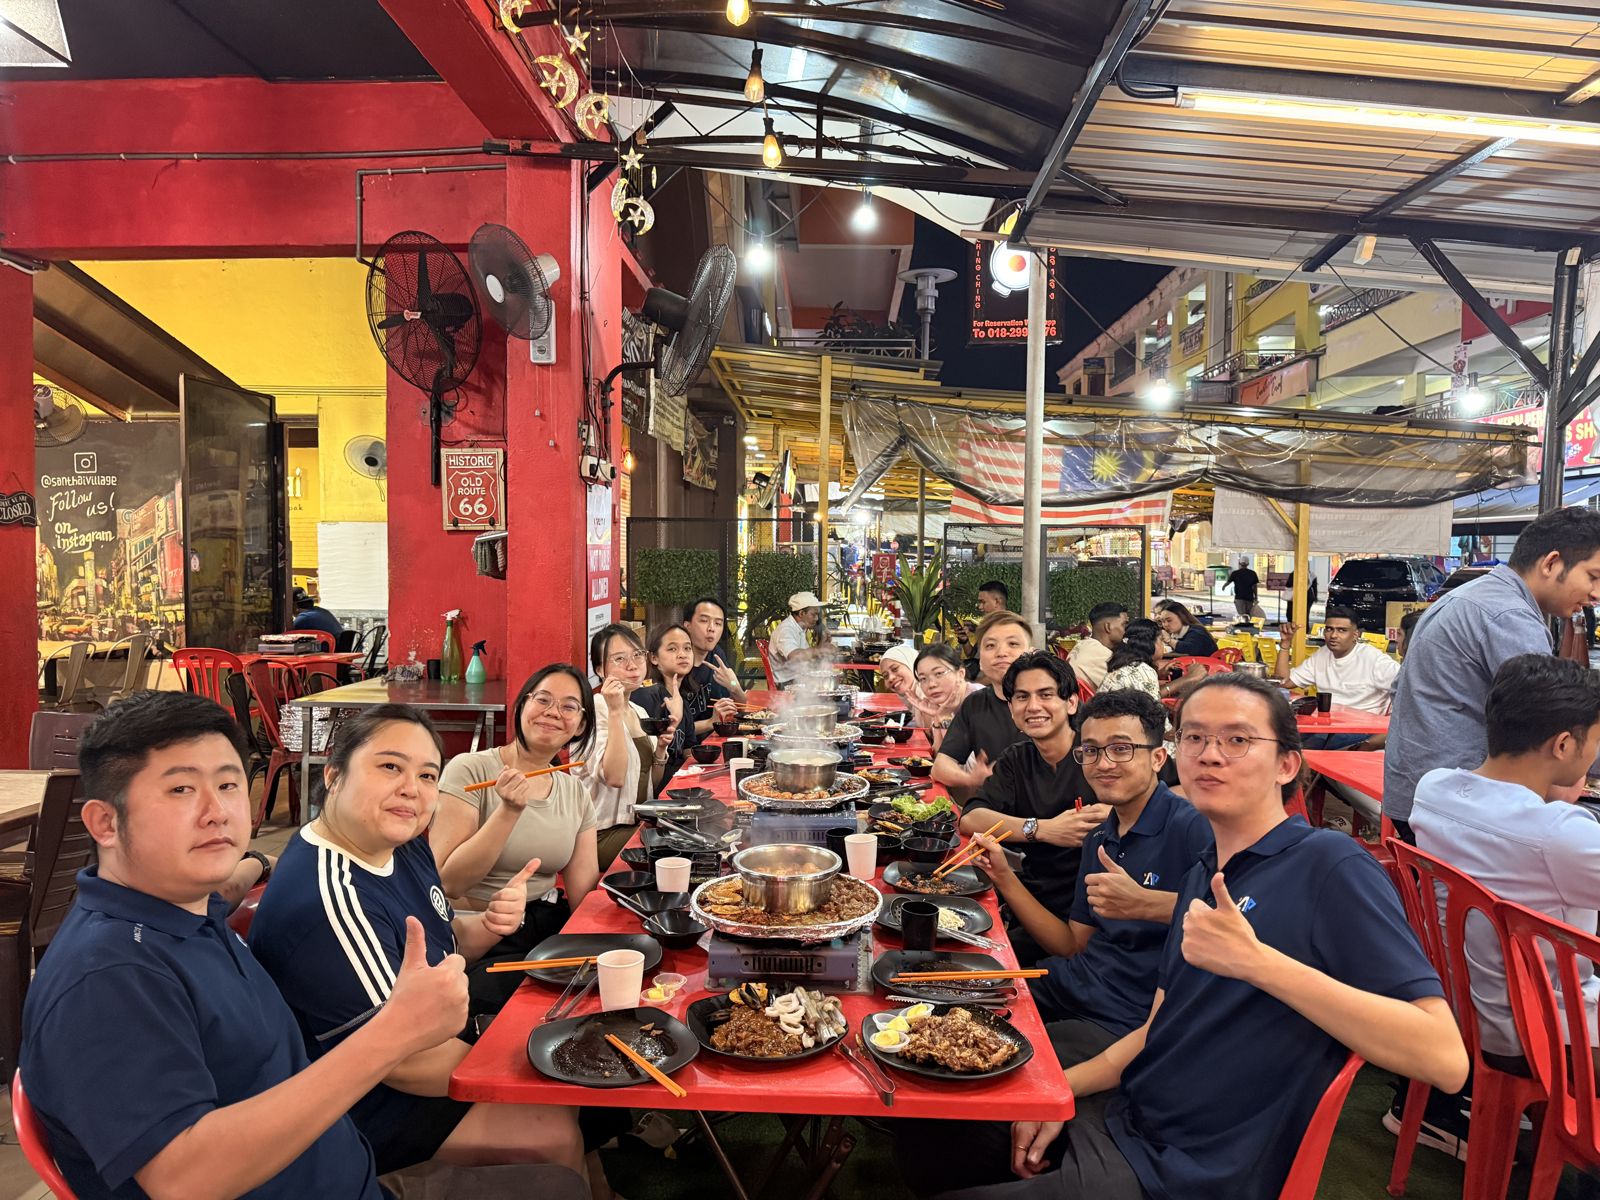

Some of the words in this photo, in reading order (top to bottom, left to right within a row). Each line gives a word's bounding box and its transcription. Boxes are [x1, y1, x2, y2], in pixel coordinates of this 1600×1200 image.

[972, 328, 985, 338] To
[449, 455, 494, 466] HISTORIC
[41, 474, 117, 488] @santhaivillage
[461, 477, 483, 487] OLD
[457, 487, 487, 496] ROUTE
[459, 497, 488, 516] 66
[54, 522, 78, 534] on
